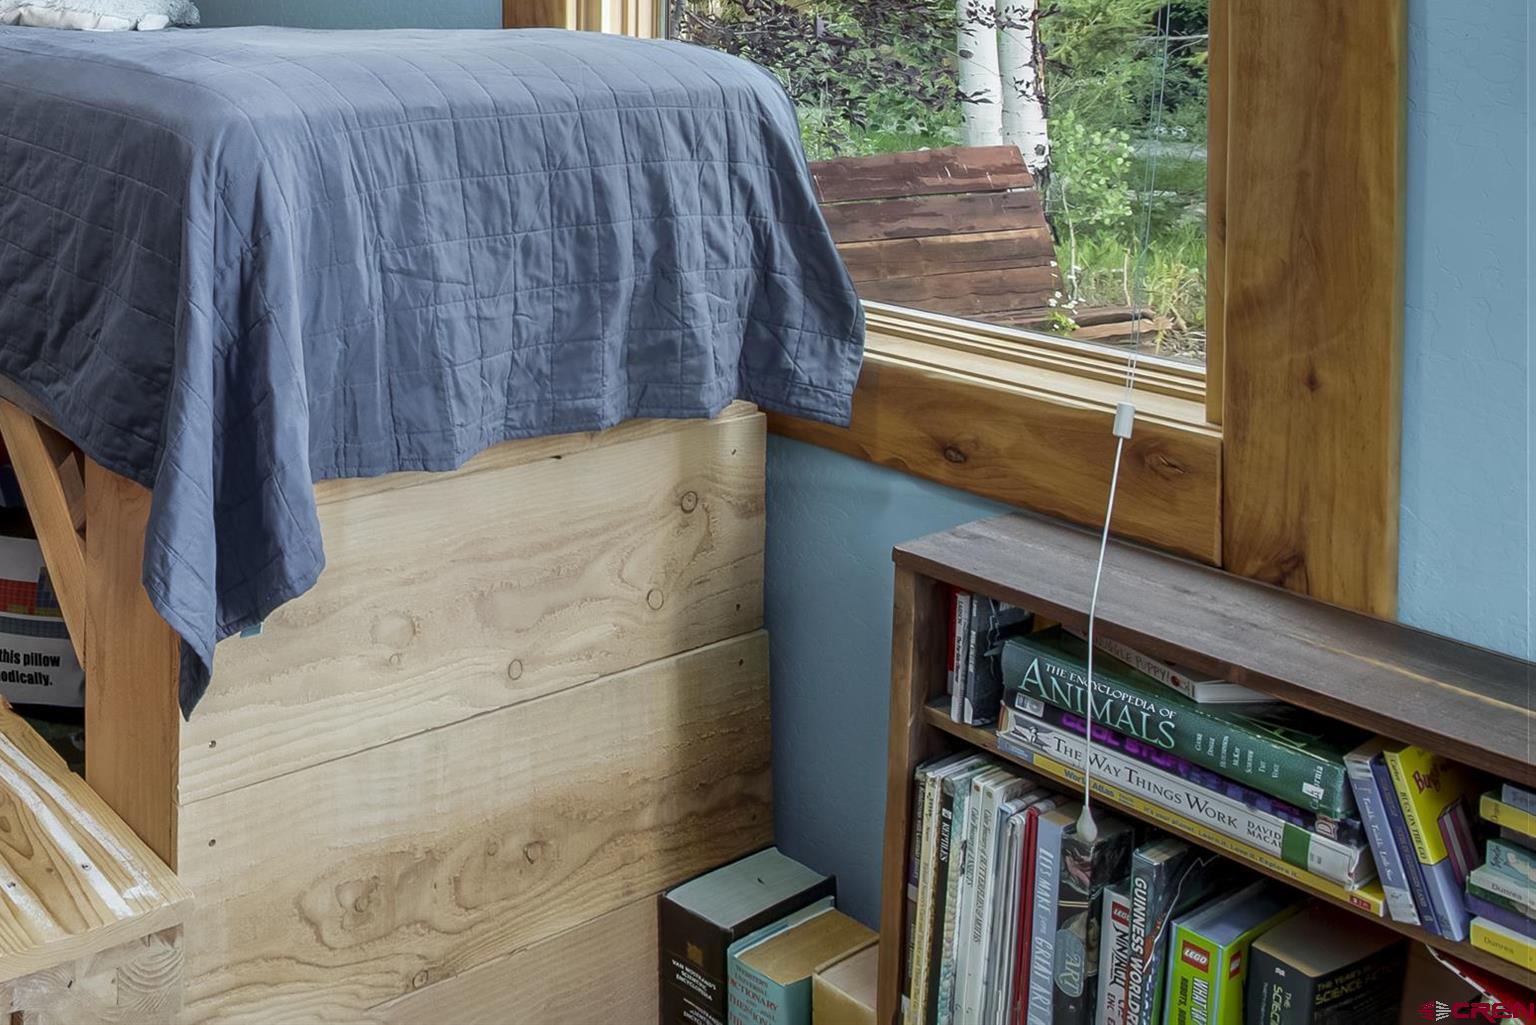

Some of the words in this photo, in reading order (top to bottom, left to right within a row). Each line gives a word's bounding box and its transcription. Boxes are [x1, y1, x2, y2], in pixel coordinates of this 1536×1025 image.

[23, 652, 61, 668] pillow
[1018, 657, 1177, 750] ANIMALS
[1045, 662, 1066, 678] THE
[1159, 707, 1177, 719] OF
[1053, 736, 1082, 762] THE
[1088, 752, 1121, 777] WAY
[1124, 766, 1183, 805] THINGS
[1185, 792, 1238, 830] WORK
[1064, 769, 1087, 788] Worl
[1091, 781, 1115, 798] Atlas
[971, 807, 982, 824] Color
[982, 808, 993, 826] Color
[1247, 820, 1282, 840] DAVID
[939, 822, 953, 864] REPTILES
[1198, 830, 1219, 844] Learn
[1410, 827, 1423, 846] THE
[1416, 845, 1427, 860] GO
[965, 854, 977, 888] INSECTS
[975, 855, 989, 910] BUTTERFLIES
[1035, 876, 1053, 914] MAKE
[1490, 882, 1523, 901] Dunrea
[973, 918, 984, 944] MOTHS
[1131, 877, 1148, 954] GUINNESS
[1031, 936, 1055, 984] GREAT
[1109, 922, 1130, 989] NINJAGO
[1183, 947, 1209, 966] LEGO
[1484, 934, 1515, 955] Dunrea
[671, 958, 685, 970] VAN
[684, 965, 717, 991] NOSTRAND'S
[675, 973, 713, 1002] ENCYCLOPEDIA
[680, 969, 708, 992] SCIENTIFIC
[1063, 953, 1082, 994] ART
[1128, 955, 1145, 1015] WORLD
[1028, 984, 1054, 1015] ART
[1191, 978, 1209, 1009] WHAT
